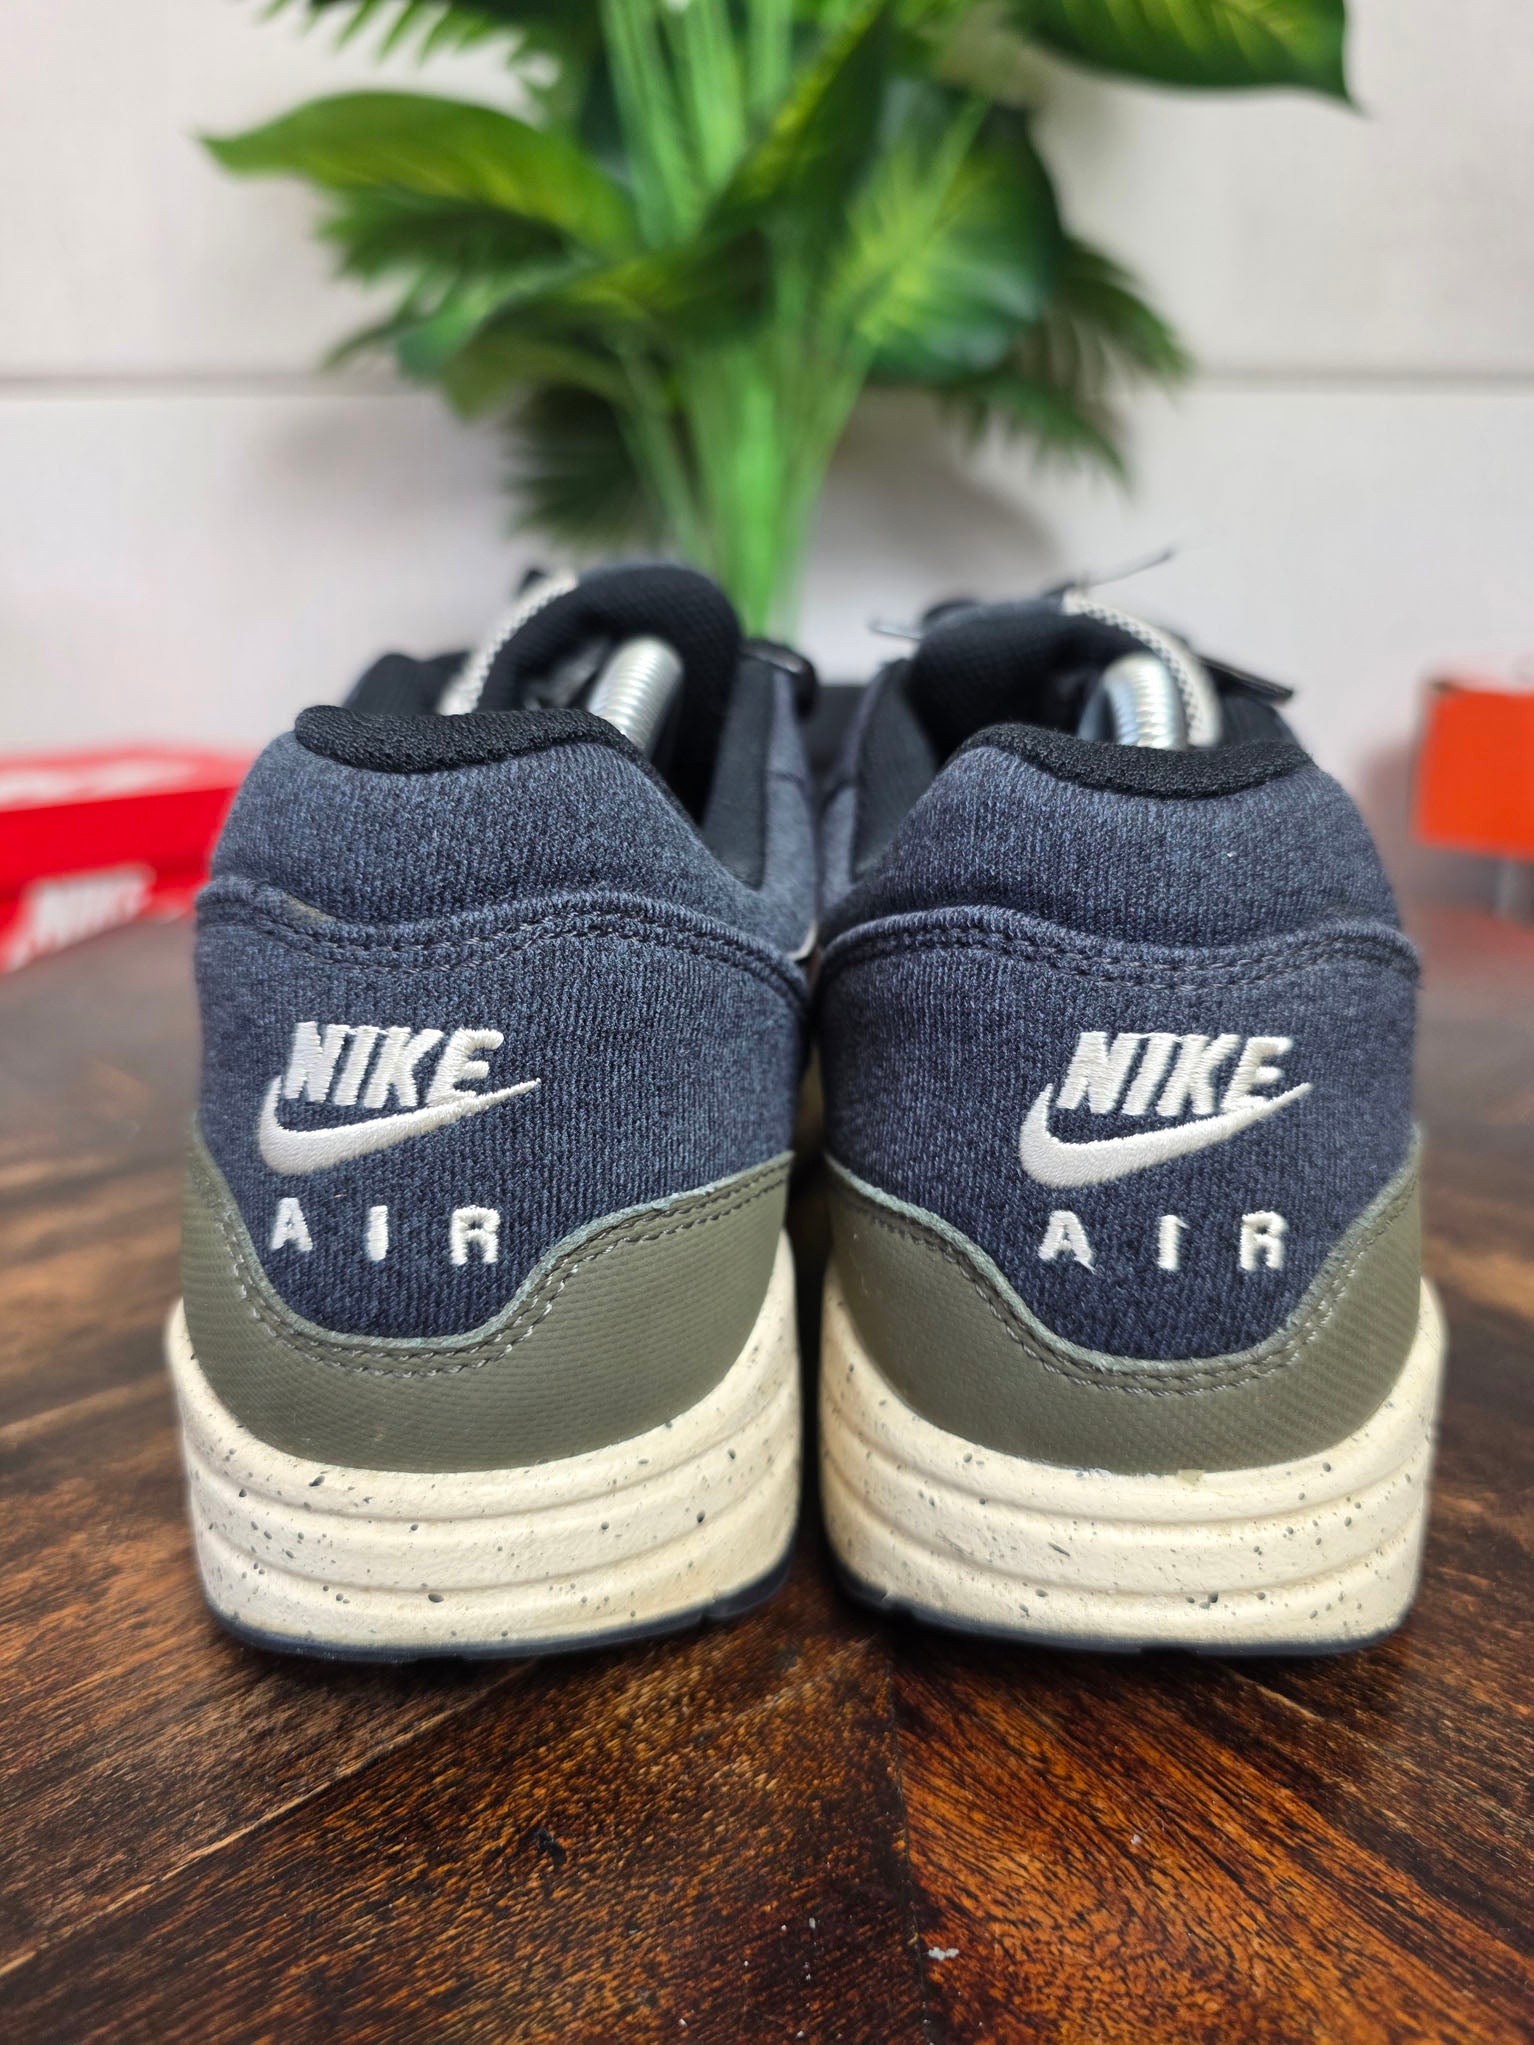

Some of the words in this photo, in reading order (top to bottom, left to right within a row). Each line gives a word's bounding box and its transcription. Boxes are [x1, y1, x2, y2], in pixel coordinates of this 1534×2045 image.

[283, 1021, 504, 1108] NIKE
[1056, 1031, 1294, 1116] NIKE
[271, 1197, 500, 1265] AIR
[1038, 1210, 1288, 1273] AIR
